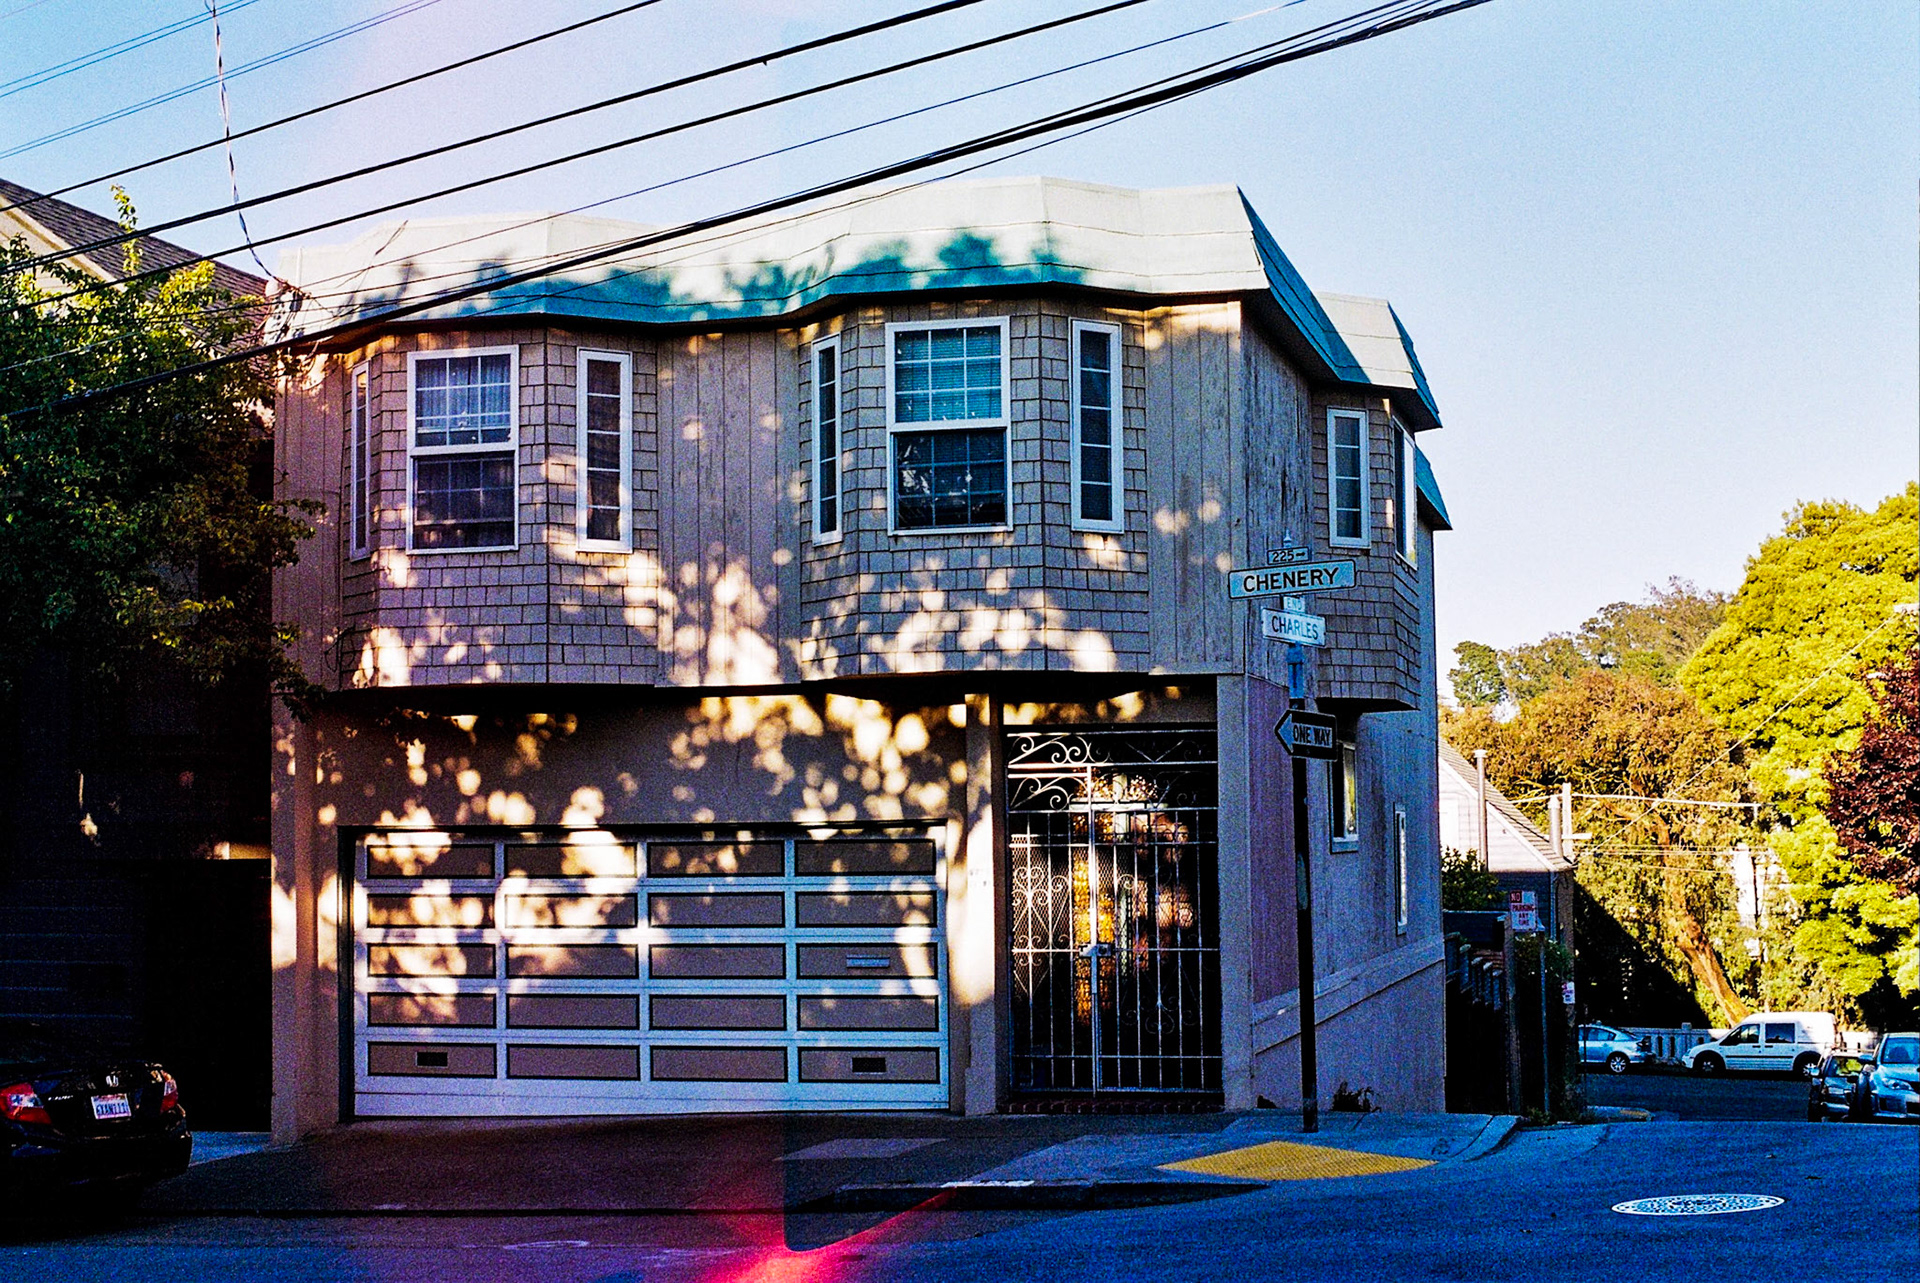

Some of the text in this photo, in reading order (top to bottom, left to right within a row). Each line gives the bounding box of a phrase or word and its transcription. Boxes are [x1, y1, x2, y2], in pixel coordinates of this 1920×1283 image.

[1272, 550, 1295, 562] 225
[1243, 567, 1339, 592] CHENERY
[1271, 615, 1319, 640] CHARLES
[1293, 724, 1331, 746] ONE WAY
[1511, 892, 1521, 901] NO
